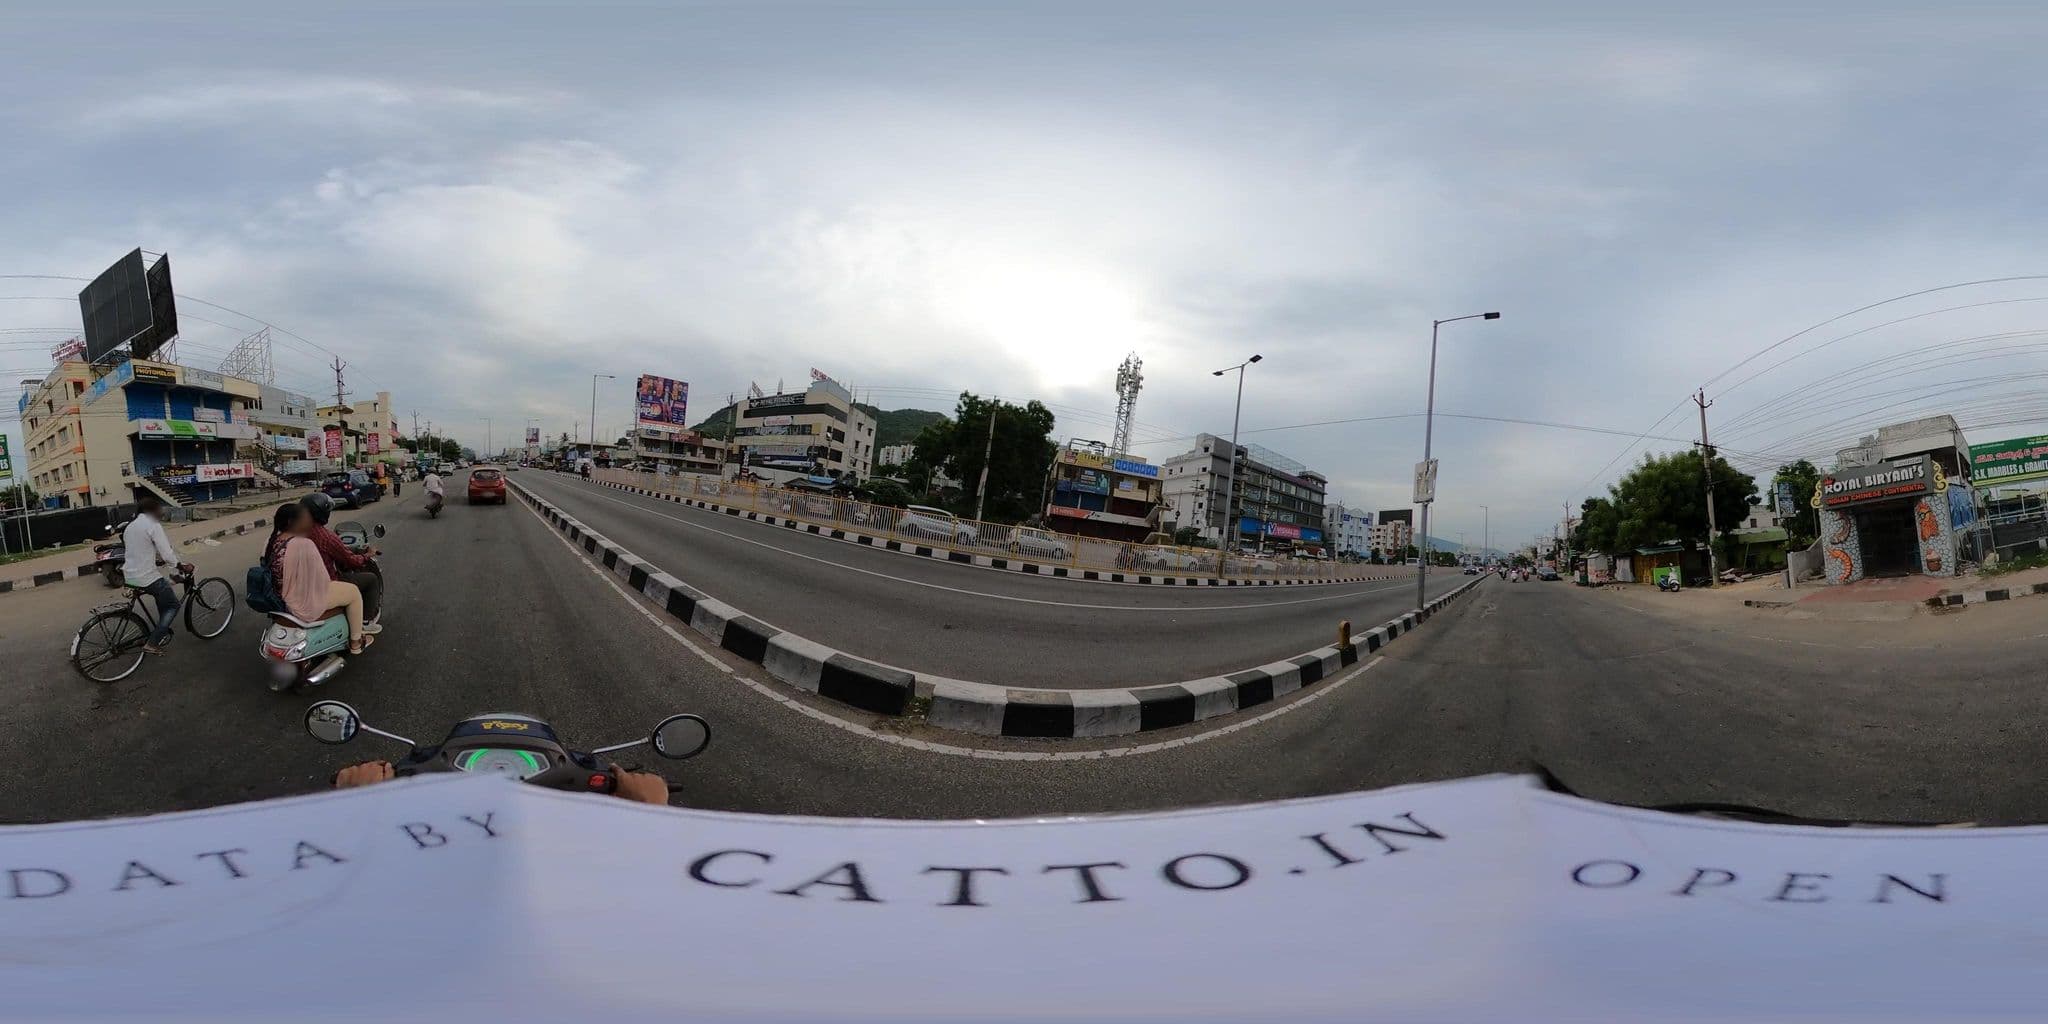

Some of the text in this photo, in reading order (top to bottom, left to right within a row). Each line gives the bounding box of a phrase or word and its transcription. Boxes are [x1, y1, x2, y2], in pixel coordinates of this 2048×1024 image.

[1824, 464, 1925, 494] ROYAL BIRYANI'S
[1987, 464, 2018, 478] MARBLES
[1851, 490, 1882, 502] CHINESE
[1883, 482, 1926, 495] CONTINENTAL
[6, 809, 504, 901] DATA BY
[687, 811, 1447, 908] CATTO.IN
[1570, 858, 1951, 906] OPEN
